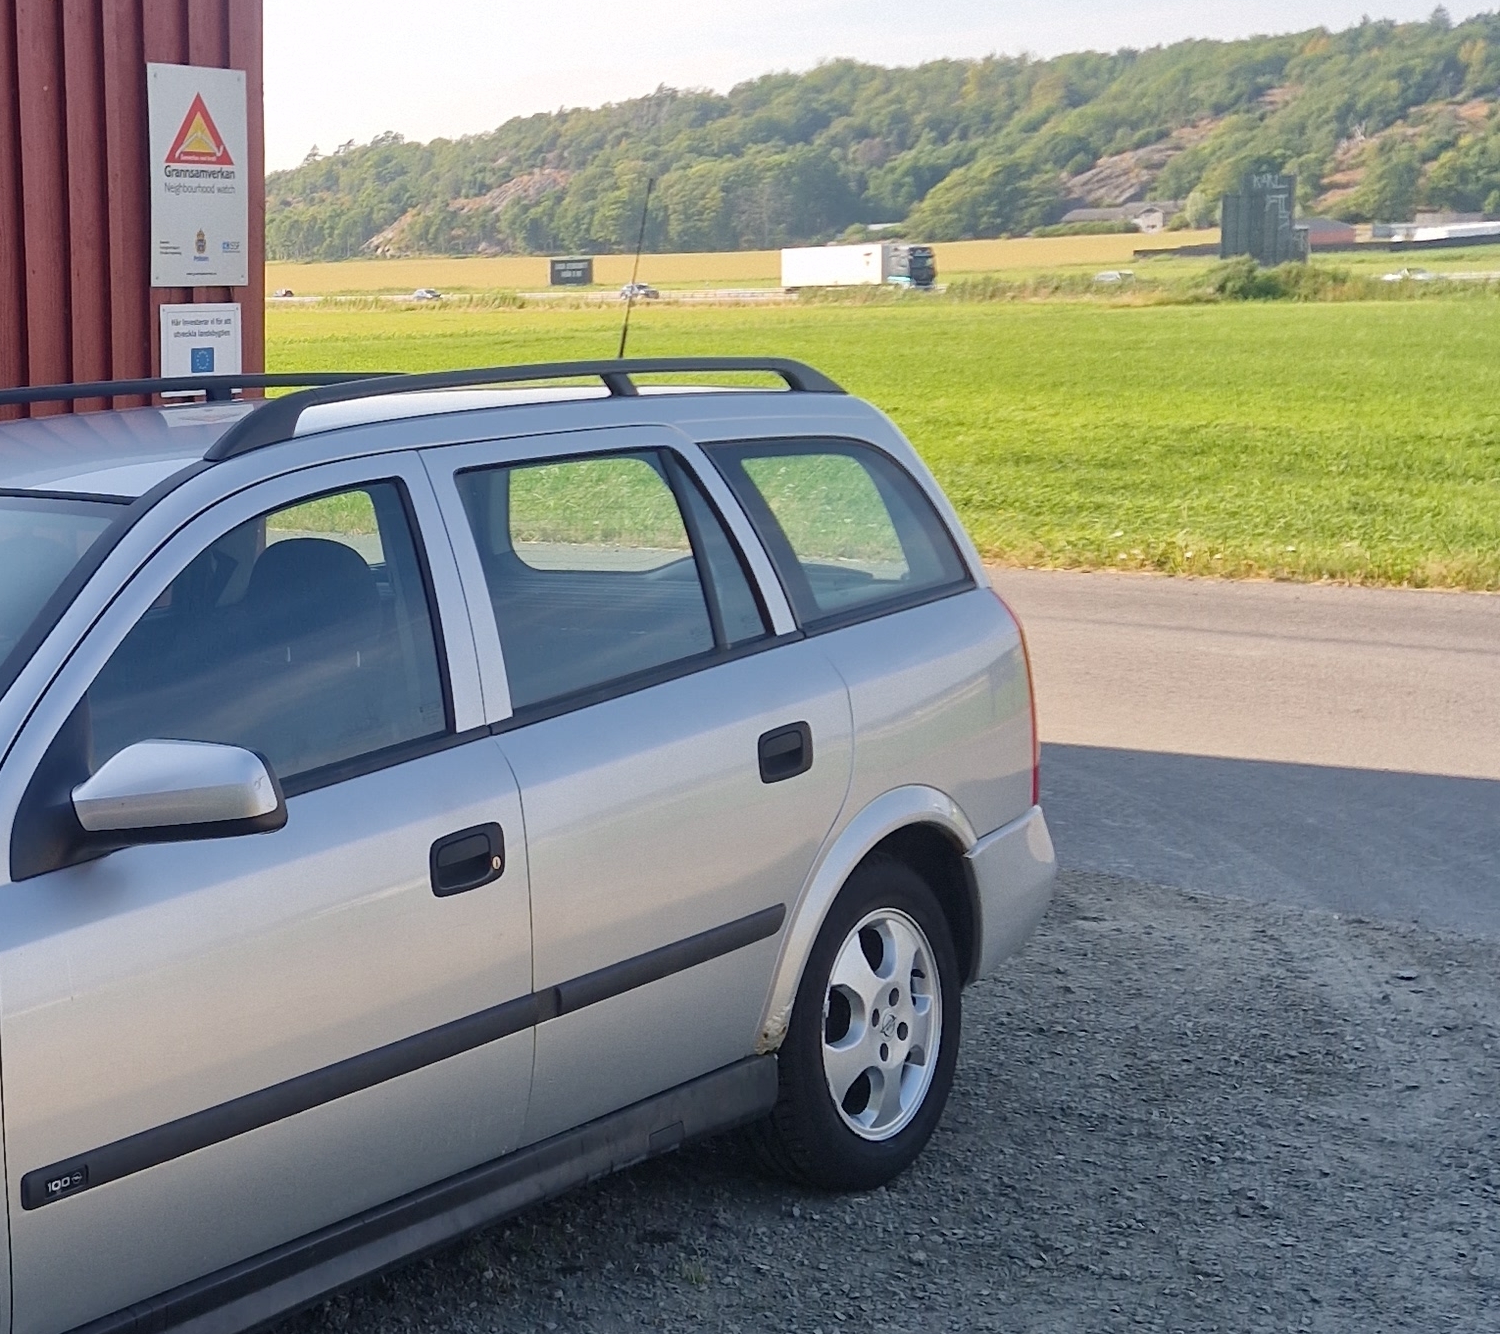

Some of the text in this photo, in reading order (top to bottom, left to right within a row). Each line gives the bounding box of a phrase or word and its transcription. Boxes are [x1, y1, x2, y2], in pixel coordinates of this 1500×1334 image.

[164, 165, 236, 179] Grannsamverkan
[164, 182, 215, 195] Neighbourhood
[48, 1177, 70, 1193] 100
